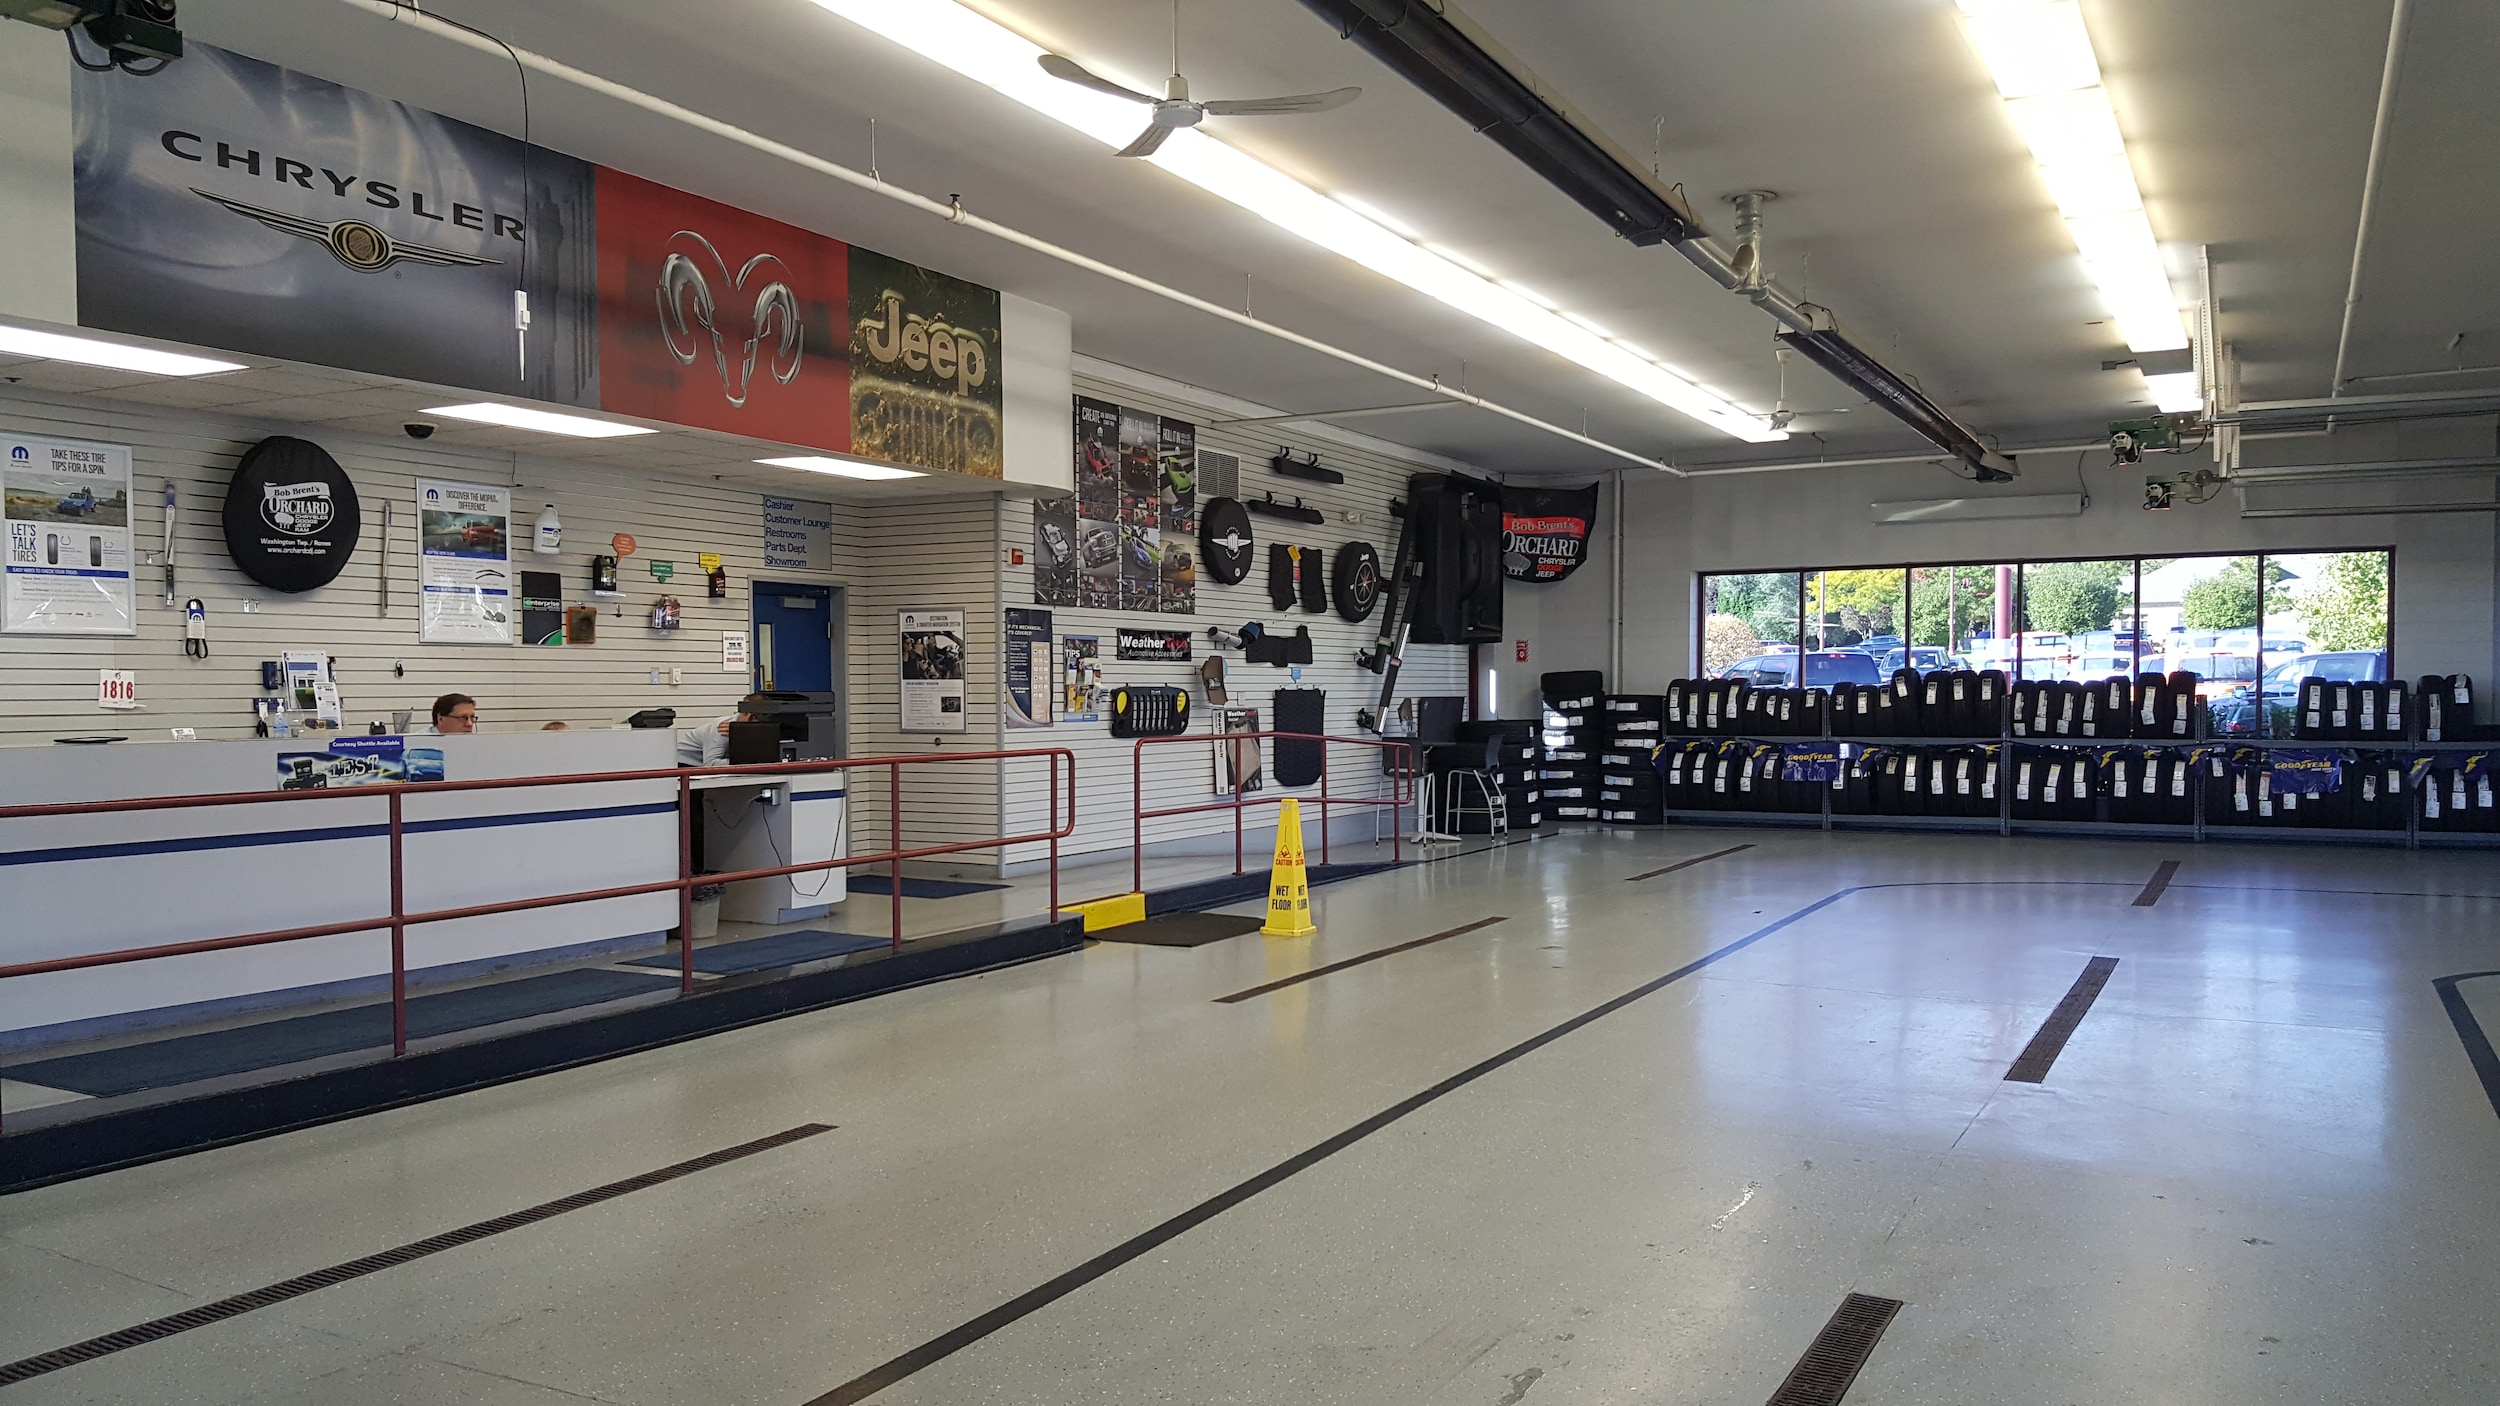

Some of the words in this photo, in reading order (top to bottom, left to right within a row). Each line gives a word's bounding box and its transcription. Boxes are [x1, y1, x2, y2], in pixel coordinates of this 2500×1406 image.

[161, 130, 525, 242] CHRYSLER
[866, 299, 986, 397] Jeep
[1082, 406, 1101, 424] CREATE
[50, 448, 68, 460] TAKE
[69, 450, 91, 462] THESE
[90, 453, 106, 463] TIRE
[51, 460, 67, 472] TIPS
[67, 462, 82, 473] FOR
[82, 464, 88, 473] A
[87, 465, 106, 475] SPIN.
[274, 489, 291, 497] Bob
[292, 486, 320, 495] Brent's
[445, 489, 470, 501] DISCOVER
[470, 492, 480, 502] THE
[268, 496, 329, 515] ORCHARD
[765, 498, 794, 511] Cashier
[765, 512, 802, 526] Customer
[803, 516, 830, 530] Lounge
[1511, 519, 1535, 531] Bob
[1537, 518, 1575, 530] Brent's
[11, 523, 36, 536] LET'S
[765, 526, 807, 540] Restrooms
[12, 536, 37, 551] TALK
[765, 541, 786, 552] Parts
[1502, 529, 1580, 557] ORCHARD
[12, 549, 37, 563] TIRES
[766, 555, 807, 567] Showroom
[1538, 557, 1576, 566] CHRYSLER
[1537, 564, 1564, 572] DODGE
[1065, 649, 1080, 658] TIPS
[103, 680, 133, 699] 1816
[1788, 752, 1833, 761] GOODYEAR
[2274, 760, 2331, 770] GOODYEAR
[1275, 859, 1293, 867] CAUTION
[1276, 884, 1289, 896] WET
[1271, 898, 1292, 911] FLOOR
